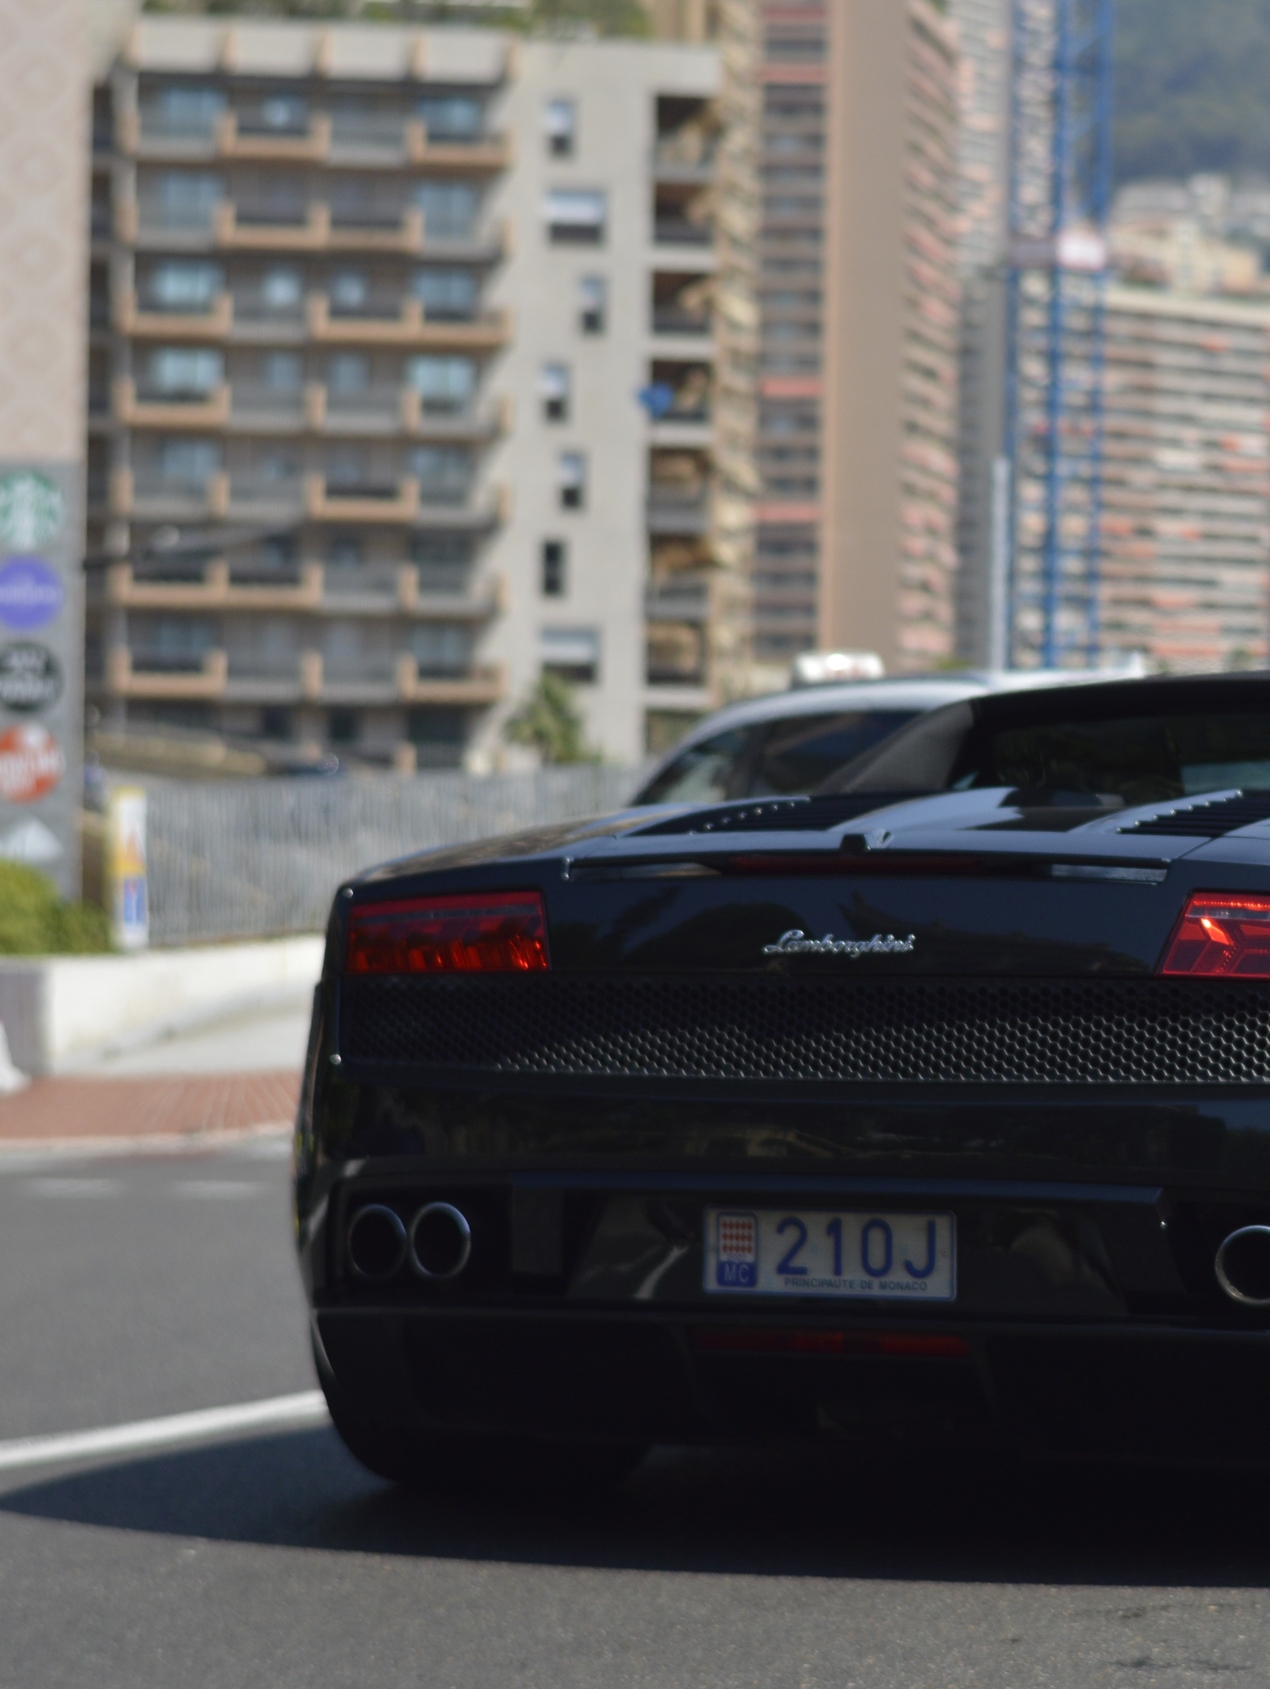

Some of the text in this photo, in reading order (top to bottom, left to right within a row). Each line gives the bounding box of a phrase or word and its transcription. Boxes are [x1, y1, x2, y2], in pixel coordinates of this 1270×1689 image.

[763, 929, 916, 958] Lamborghini
[776, 1217, 936, 1279] 210J
[724, 1264, 750, 1283] MC
[784, 1277, 928, 1292] PRINCIPAUTE DE MONACO
